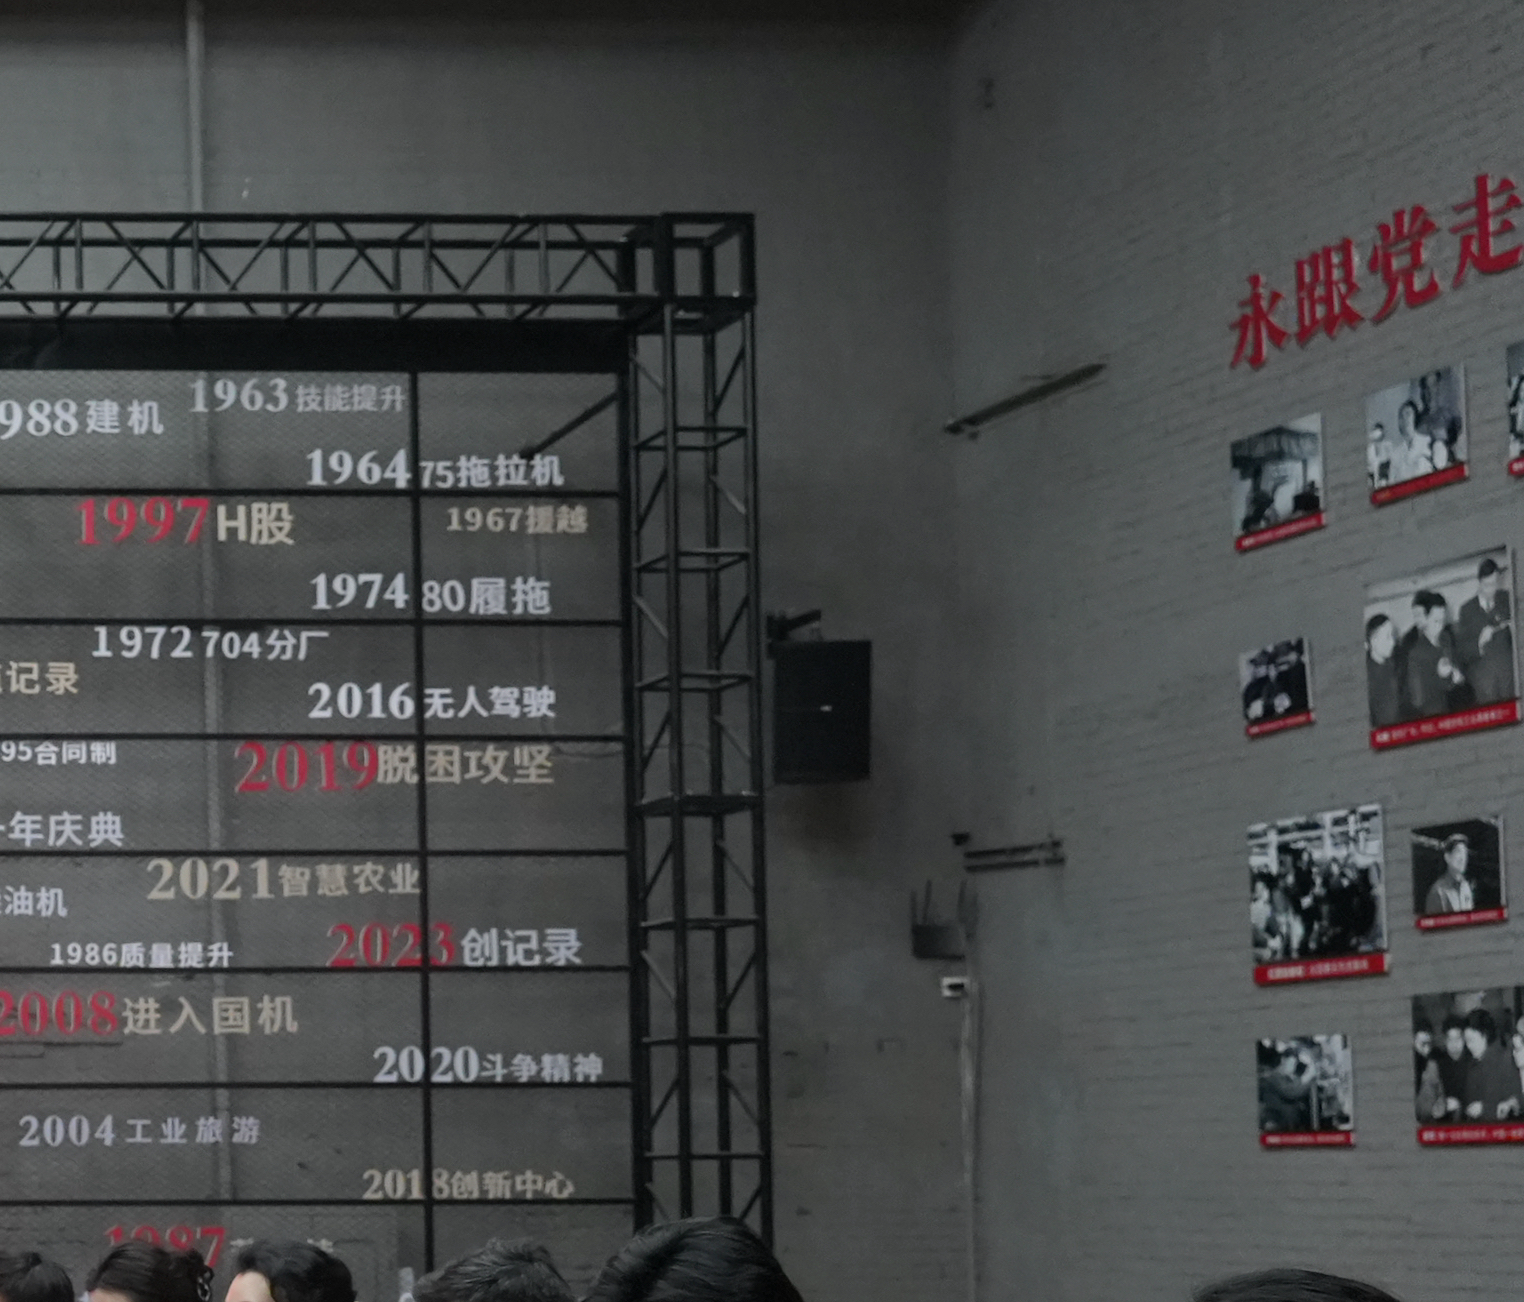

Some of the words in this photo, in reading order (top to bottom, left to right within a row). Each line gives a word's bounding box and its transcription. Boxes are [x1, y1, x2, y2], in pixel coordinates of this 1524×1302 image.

[190, 377, 289, 414] 1963
[296, 384, 406, 412] 技能提升
[86, 399, 164, 435] 建机
[306, 448, 412, 488] 1964
[419, 454, 565, 488] 75拖拉机
[74, 498, 211, 546] 1997
[216, 502, 295, 546] H股
[310, 572, 410, 611] 1974
[421, 578, 551, 616] 80履拖
[91, 625, 194, 660] 1972
[201, 629, 331, 661] 704分厂
[307, 682, 416, 720] 2016
[423, 686, 557, 719] 无人驾驶
[235, 740, 378, 794] 2019
[377, 744, 554, 786] 脱困攻坚
[146, 857, 276, 902] 2021
[279, 862, 422, 898] 智慧农业
[327, 922, 456, 968] 2023
[461, 928, 583, 968] 创记录
[122, 995, 299, 1036] 进入国机
[372, 1046, 480, 1083] 2020
[481, 1053, 604, 1083] 斗争精神
[18, 1114, 116, 1148] 2004
[125, 1116, 262, 1146] 工业旅游
